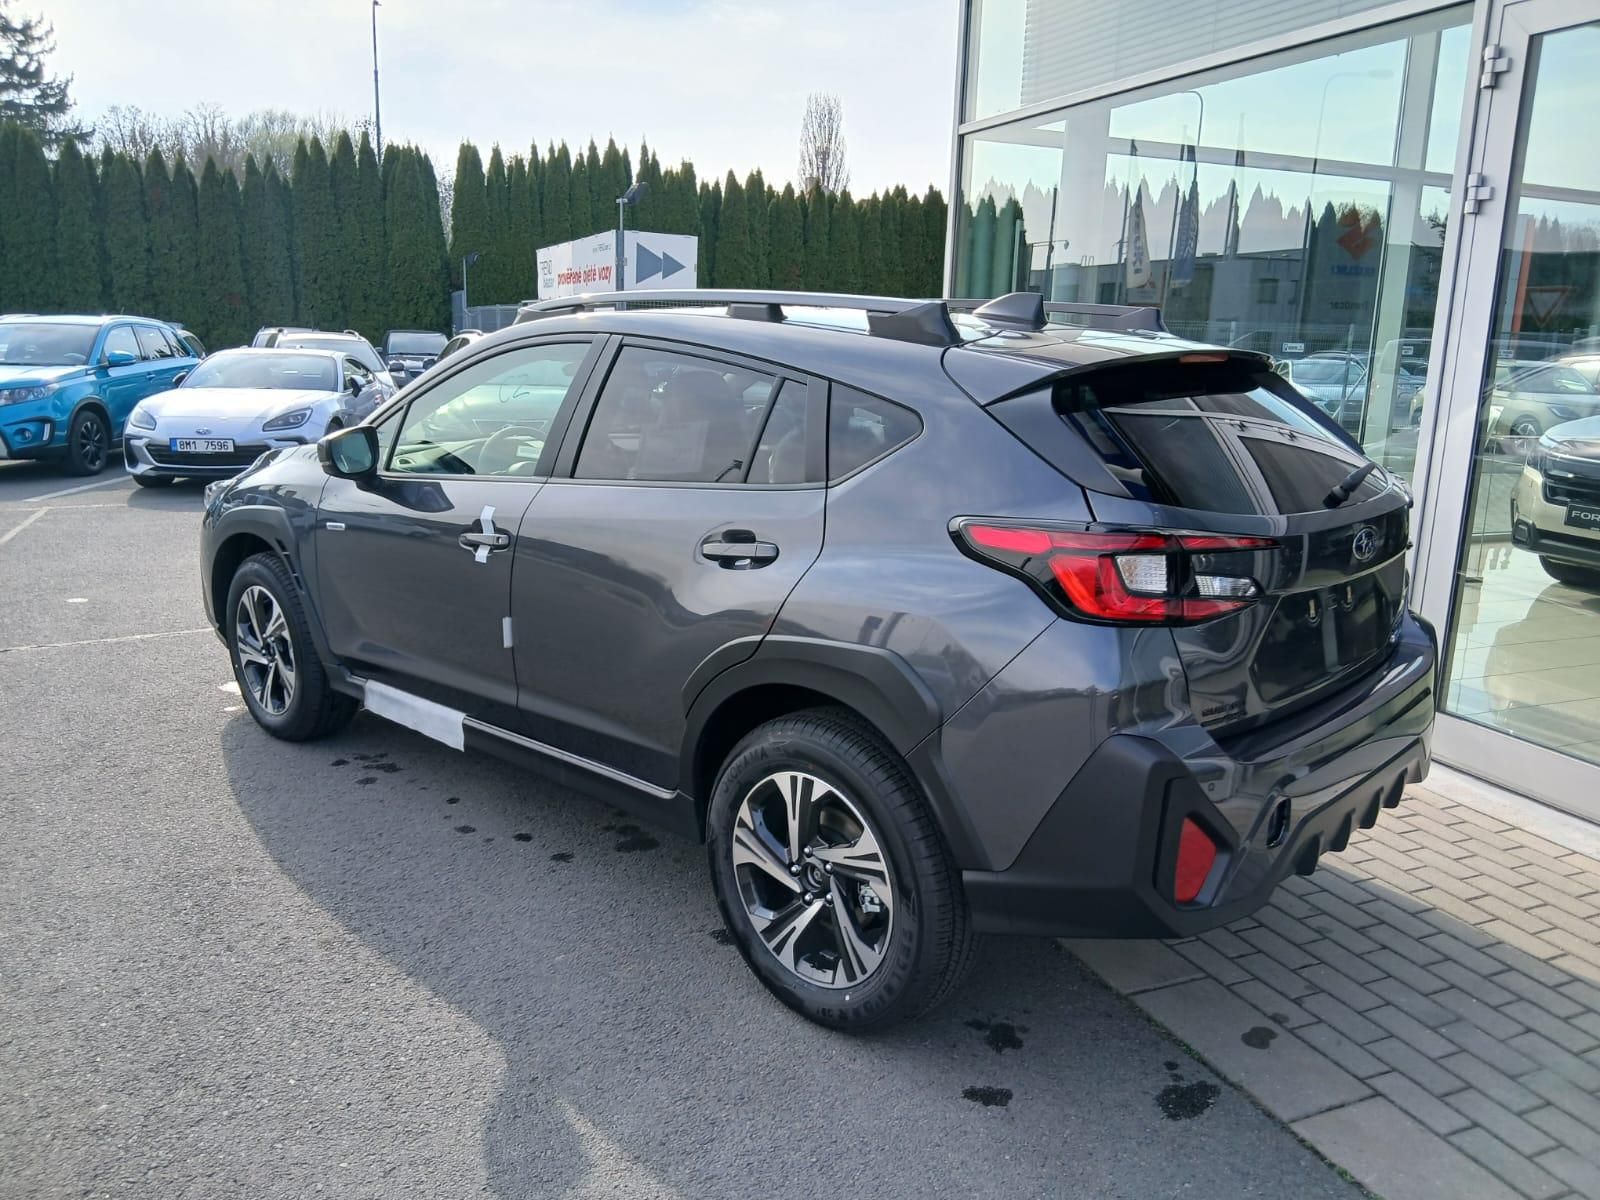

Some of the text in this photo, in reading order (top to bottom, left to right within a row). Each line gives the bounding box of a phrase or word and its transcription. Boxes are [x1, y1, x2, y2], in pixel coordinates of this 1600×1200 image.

[597, 265, 612, 284] vozy
[179, 441, 229, 450] 8M1 7596
